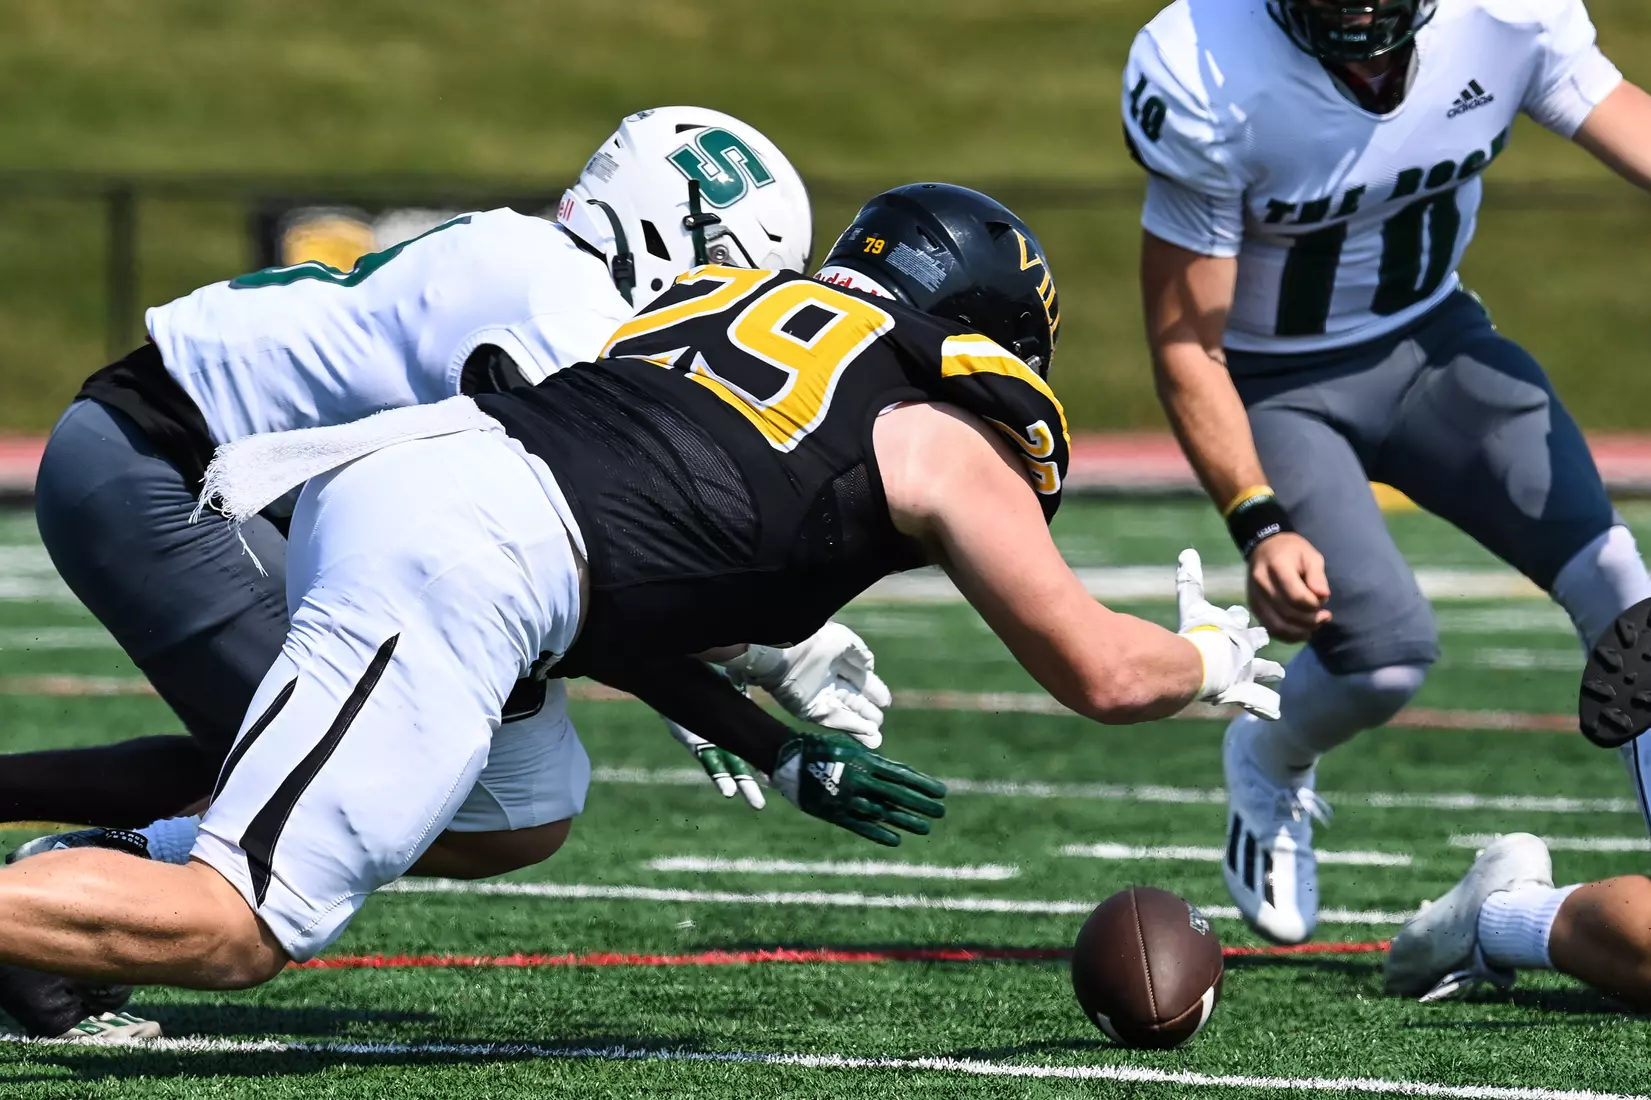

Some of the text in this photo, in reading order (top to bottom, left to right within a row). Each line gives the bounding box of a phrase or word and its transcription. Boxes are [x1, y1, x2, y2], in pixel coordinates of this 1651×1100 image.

[665, 126, 776, 209] S
[863, 236, 886, 254] 79
[1275, 188, 1460, 336] 10
[599, 263, 896, 453] 79
